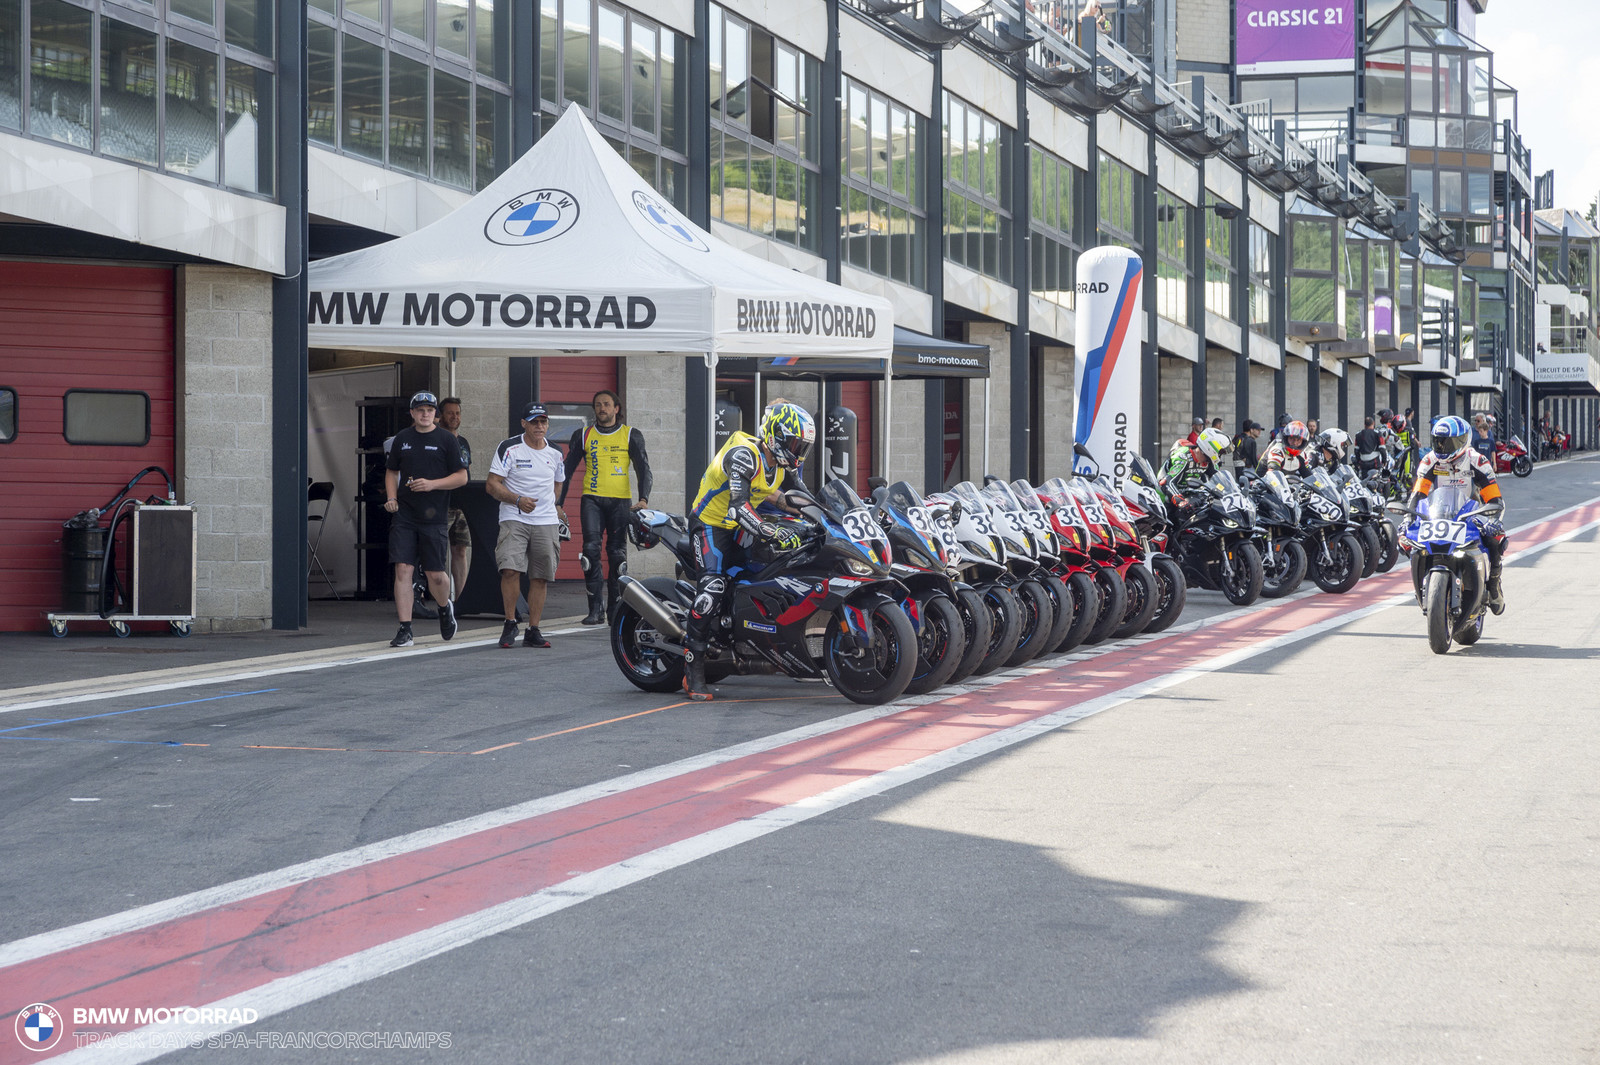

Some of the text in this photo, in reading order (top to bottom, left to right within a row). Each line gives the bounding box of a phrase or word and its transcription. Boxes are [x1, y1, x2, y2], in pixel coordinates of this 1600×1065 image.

[1247, 8, 1343, 27] CLASSIC 21
[508, 191, 573, 211] BMW
[402, 292, 657, 330] MOTORRAD
[737, 298, 876, 339] BMW MOTORRAD
[918, 353, 979, 366] bmc-moto.com
[590, 439, 599, 492] TRACKDAYS
[1308, 495, 1341, 521] 250
[1419, 520, 1466, 541] 397
